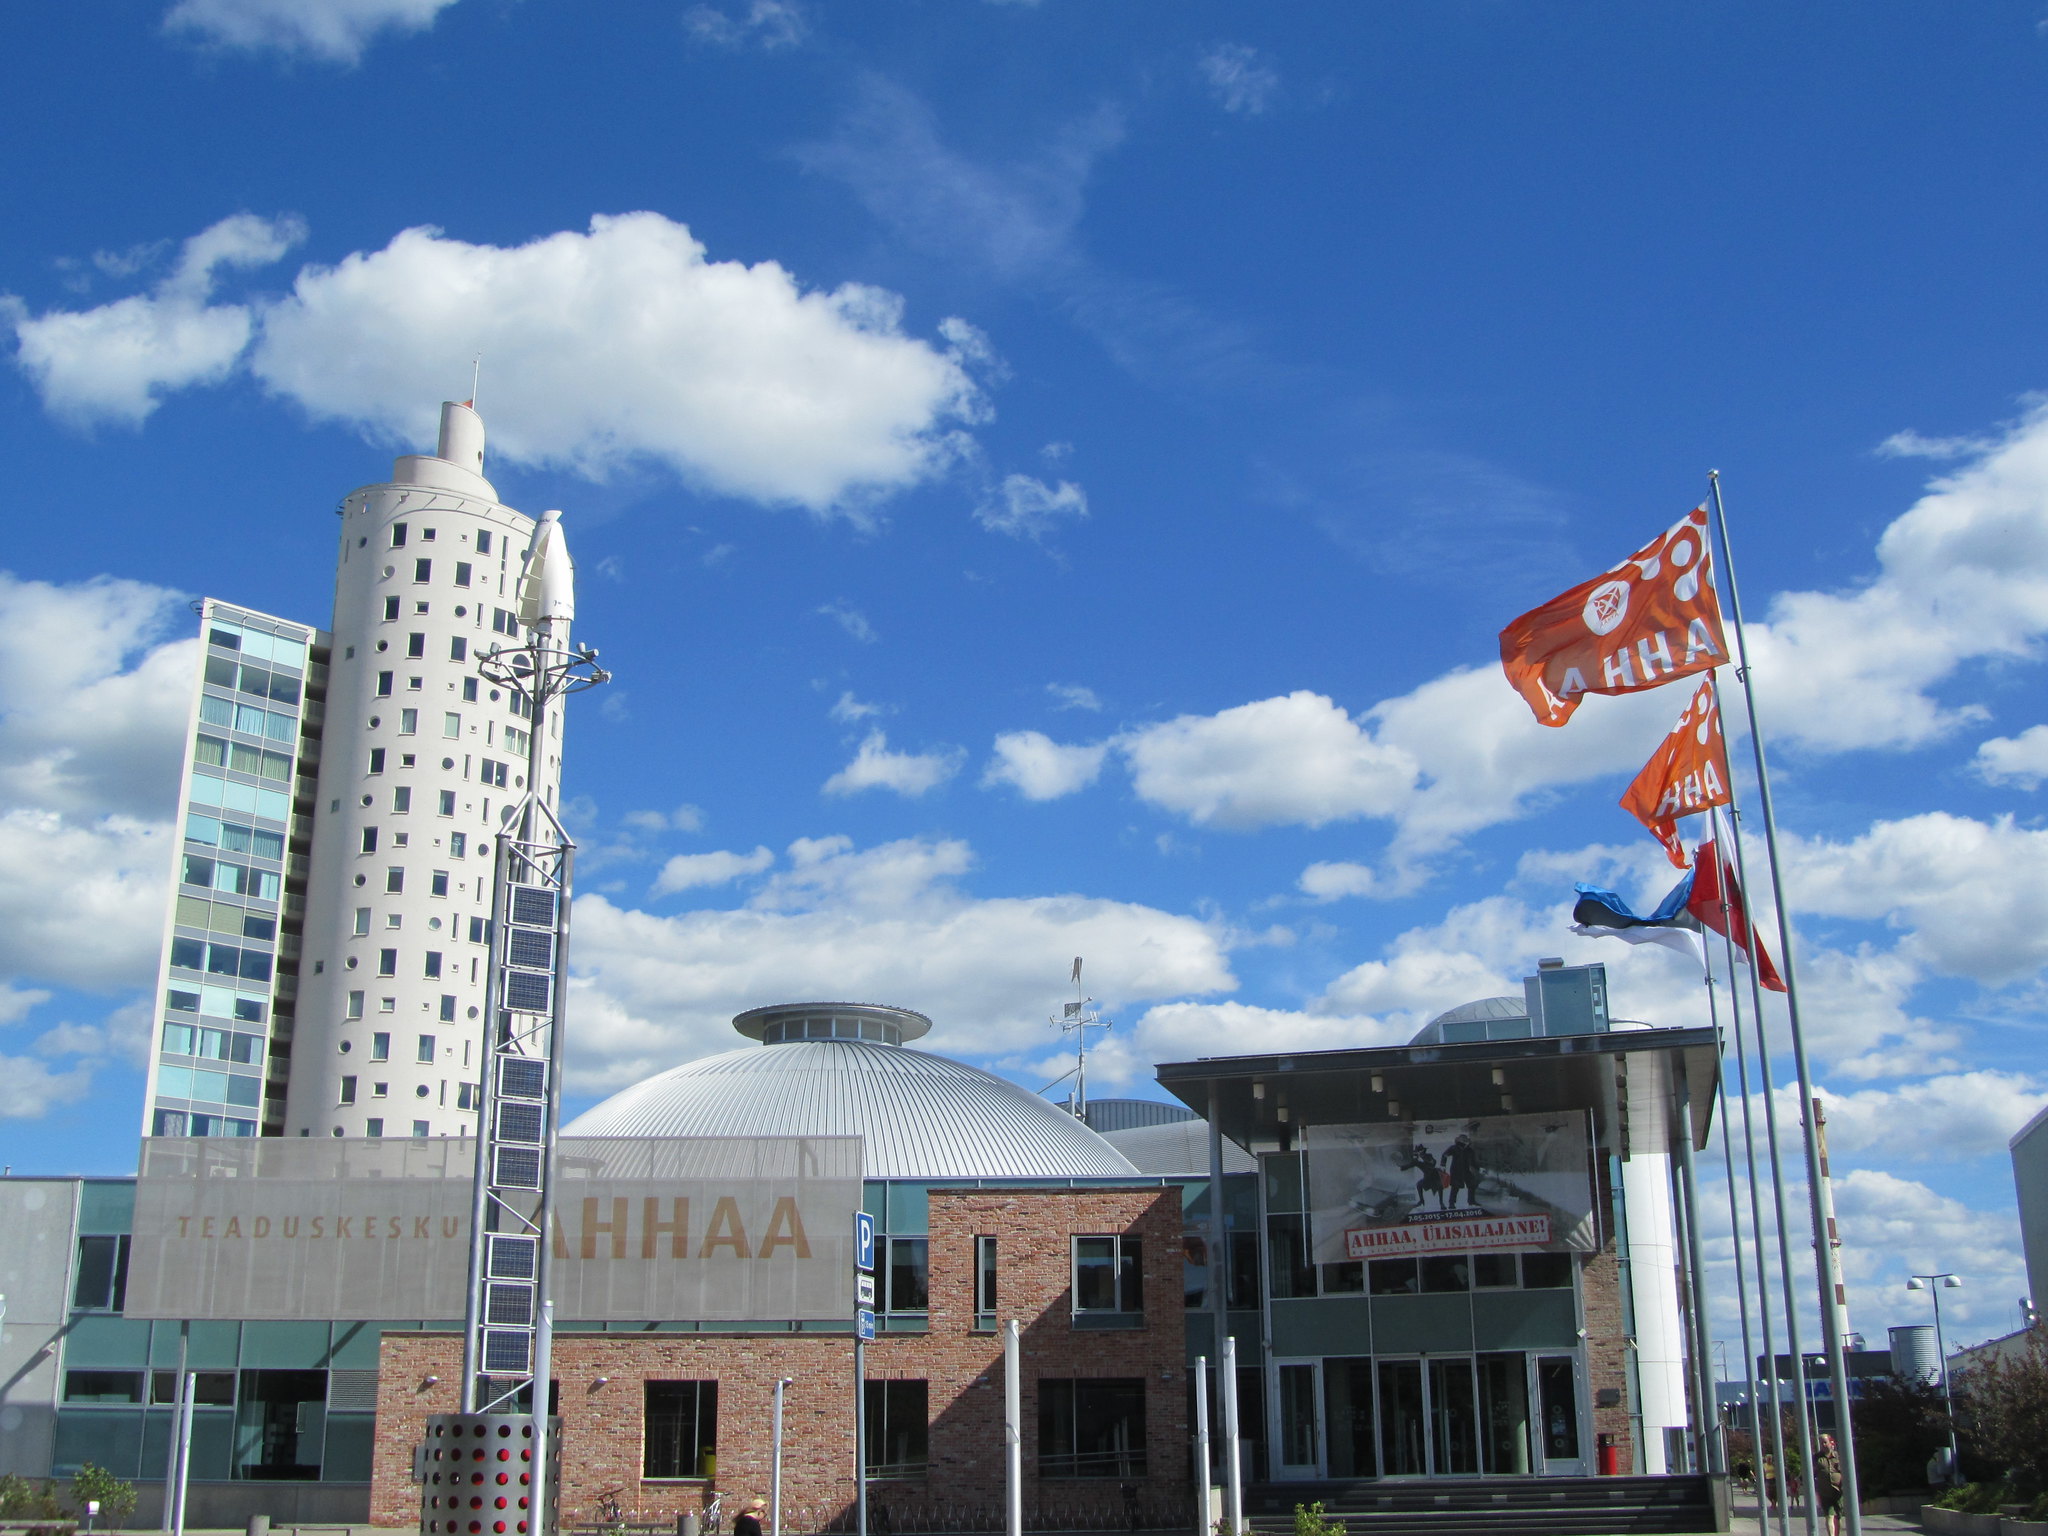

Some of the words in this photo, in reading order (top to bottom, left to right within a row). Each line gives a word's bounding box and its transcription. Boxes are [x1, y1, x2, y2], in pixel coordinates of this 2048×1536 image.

[178, 1215, 459, 1239] TEADUSKESKU
[861, 1219, 871, 1262] P
[1351, 1230, 1417, 1249] AHHAA,
[1423, 1219, 1546, 1242] ÜLISALAJANE!
